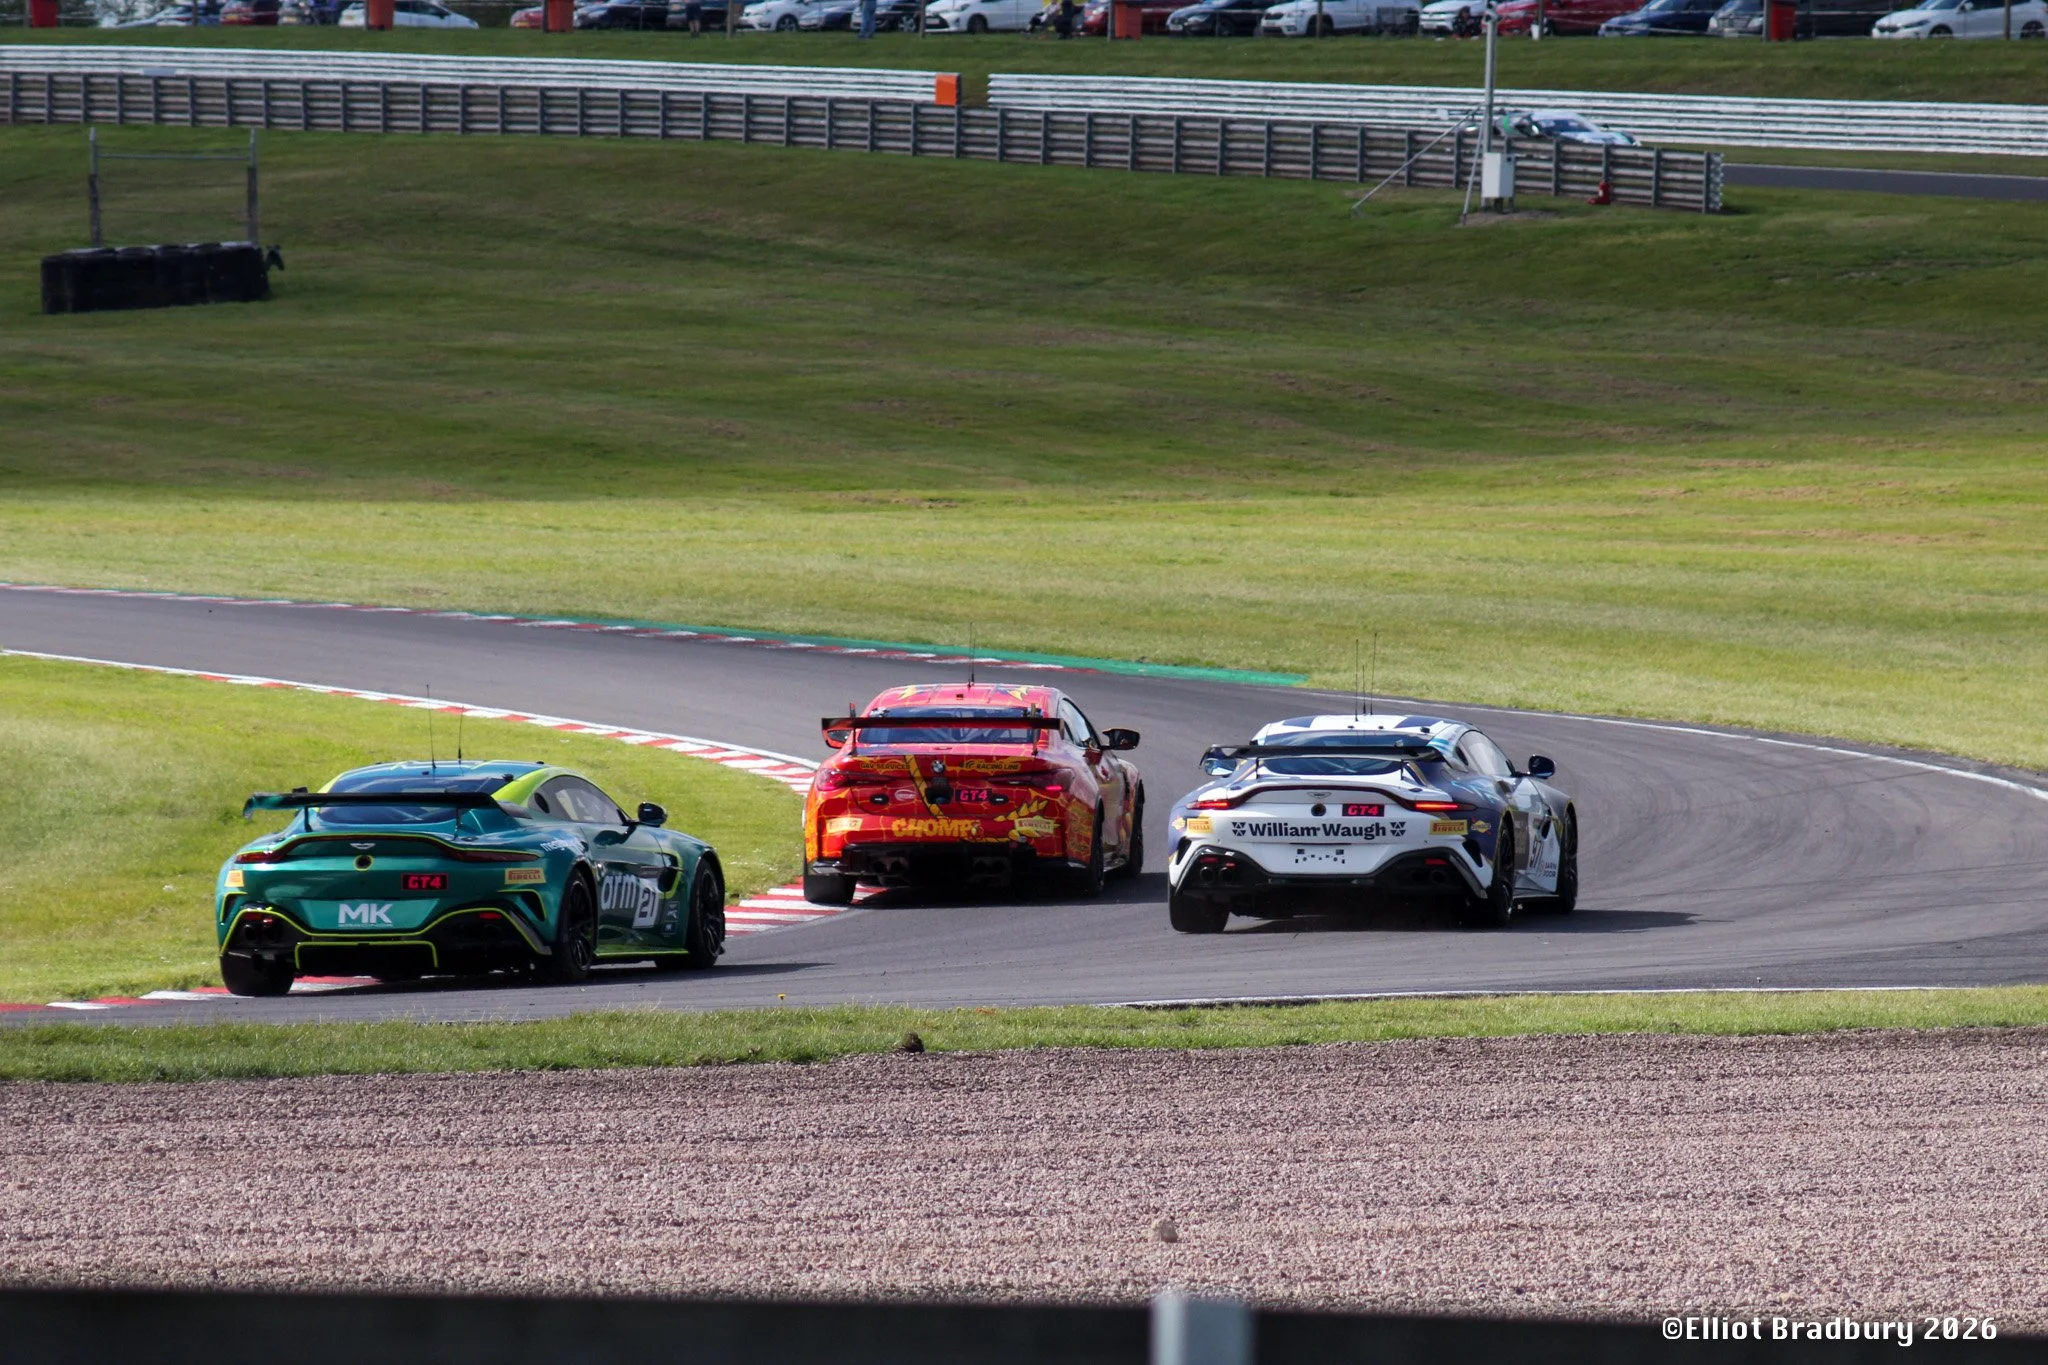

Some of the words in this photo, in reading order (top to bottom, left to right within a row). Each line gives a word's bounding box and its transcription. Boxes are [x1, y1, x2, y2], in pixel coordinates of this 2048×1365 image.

[959, 789, 988, 800] GT4
[1347, 804, 1379, 816] GT4
[892, 817, 972, 837] CHOMP
[1249, 822, 1319, 837] William
[1322, 822, 1386, 840] Waugh
[1432, 821, 1465, 833] PIRELLI
[508, 869, 541, 880] PIRELLI
[408, 876, 441, 889] GT4
[338, 903, 393, 924] MK
